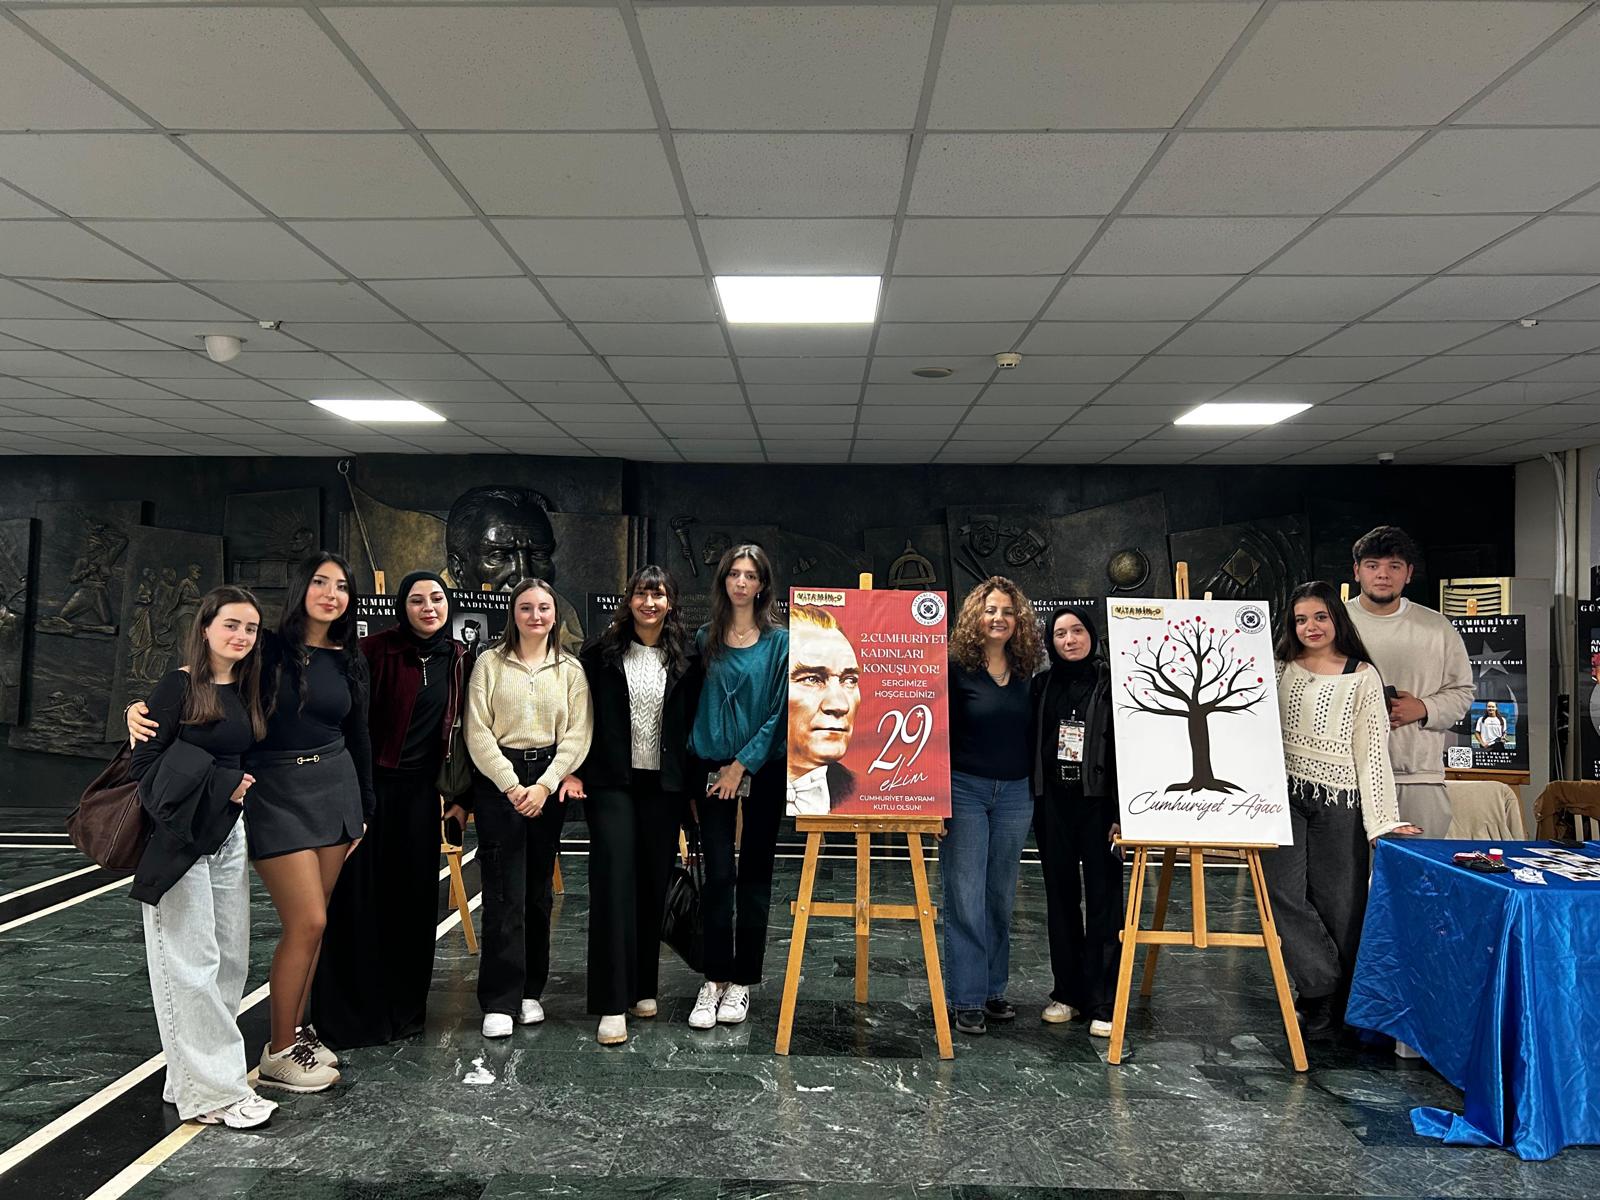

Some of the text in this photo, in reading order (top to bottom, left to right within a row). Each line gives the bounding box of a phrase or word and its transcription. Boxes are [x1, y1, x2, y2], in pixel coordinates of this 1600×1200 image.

[453, 591, 474, 600] ESKİ
[1452, 618, 1519, 626] CUMHURİYET
[861, 632, 947, 644] 2.CUMHURİYET
[861, 649, 924, 659] KADINLARI
[863, 664, 940, 676] KONUŞUYOR!
[881, 679, 928, 688] SERGİMİZE
[874, 690, 935, 699] HOŞGELDİNİZ!
[868, 704, 933, 774] 29
[880, 757, 928, 791] ekim
[1128, 790, 1283, 820] Cumhuriyet Ağacı
